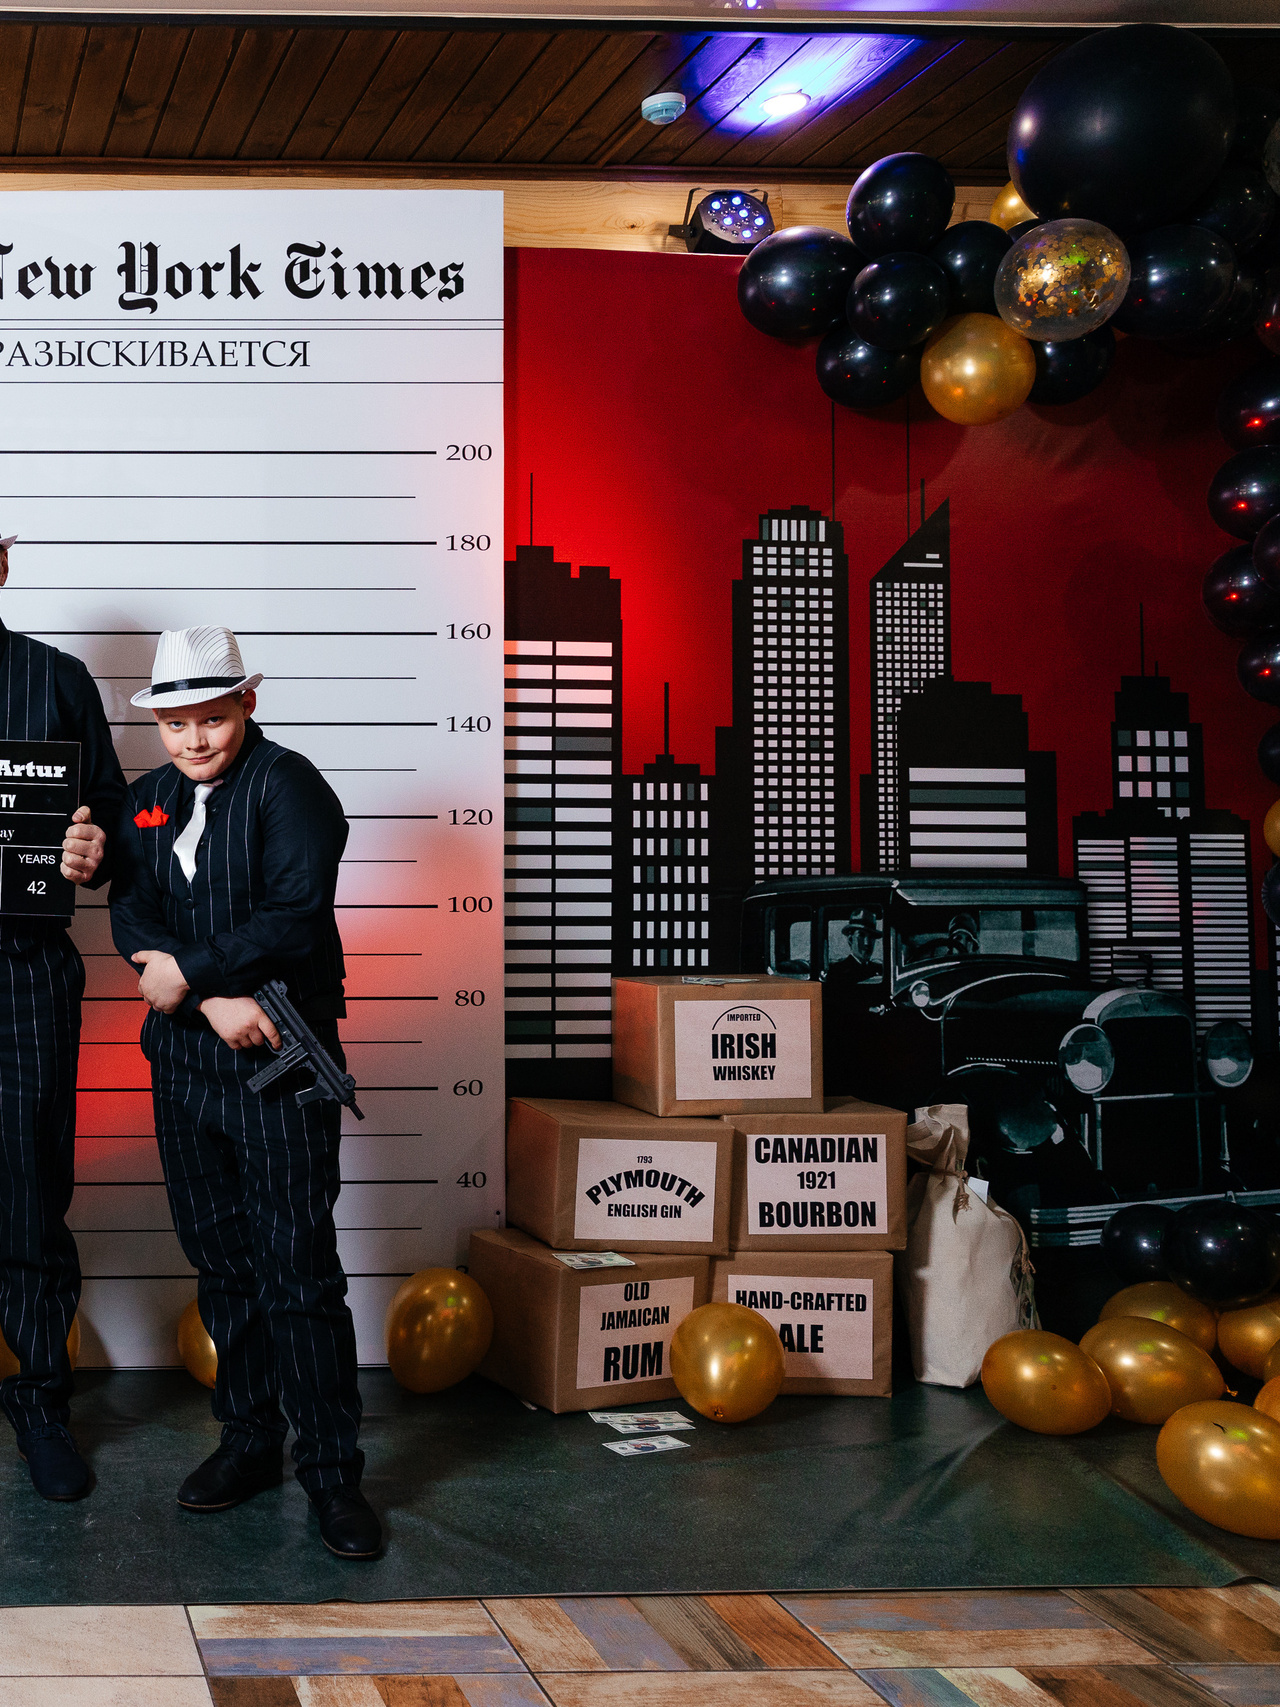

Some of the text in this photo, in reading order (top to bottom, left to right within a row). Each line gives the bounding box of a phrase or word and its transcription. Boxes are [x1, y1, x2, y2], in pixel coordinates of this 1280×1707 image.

[116, 241, 265, 314] York
[284, 241, 465, 303] Times
[445, 444, 493, 461] 200
[445, 534, 492, 552] 180
[446, 622, 492, 640] 160
[446, 715, 492, 733] 140
[448, 808, 494, 826] 120
[18, 854, 56, 865] YEARS
[26, 880, 47, 895] 42
[447, 896, 494, 913] 100
[454, 989, 486, 1007] 80
[726, 1013, 761, 1022] IMPORTED
[711, 1033, 777, 1060] IRISH
[712, 1065, 776, 1081] WHISKEY
[452, 1079, 484, 1097] 60
[754, 1137, 878, 1163] CANADIAN
[636, 1155, 653, 1164] 1793
[456, 1171, 487, 1189] 40
[585, 1169, 706, 1208] PLYMOUTH
[796, 1171, 836, 1190] 1921
[607, 1204, 682, 1219] ENGLISH GIN
[758, 1201, 877, 1228] BOURBON
[624, 1282, 650, 1302] OLD
[735, 1290, 867, 1312] HAND-CRAFTED
[600, 1306, 670, 1331] JAMAICAN
[779, 1323, 824, 1353] ALE
[603, 1341, 664, 1382] RUM
